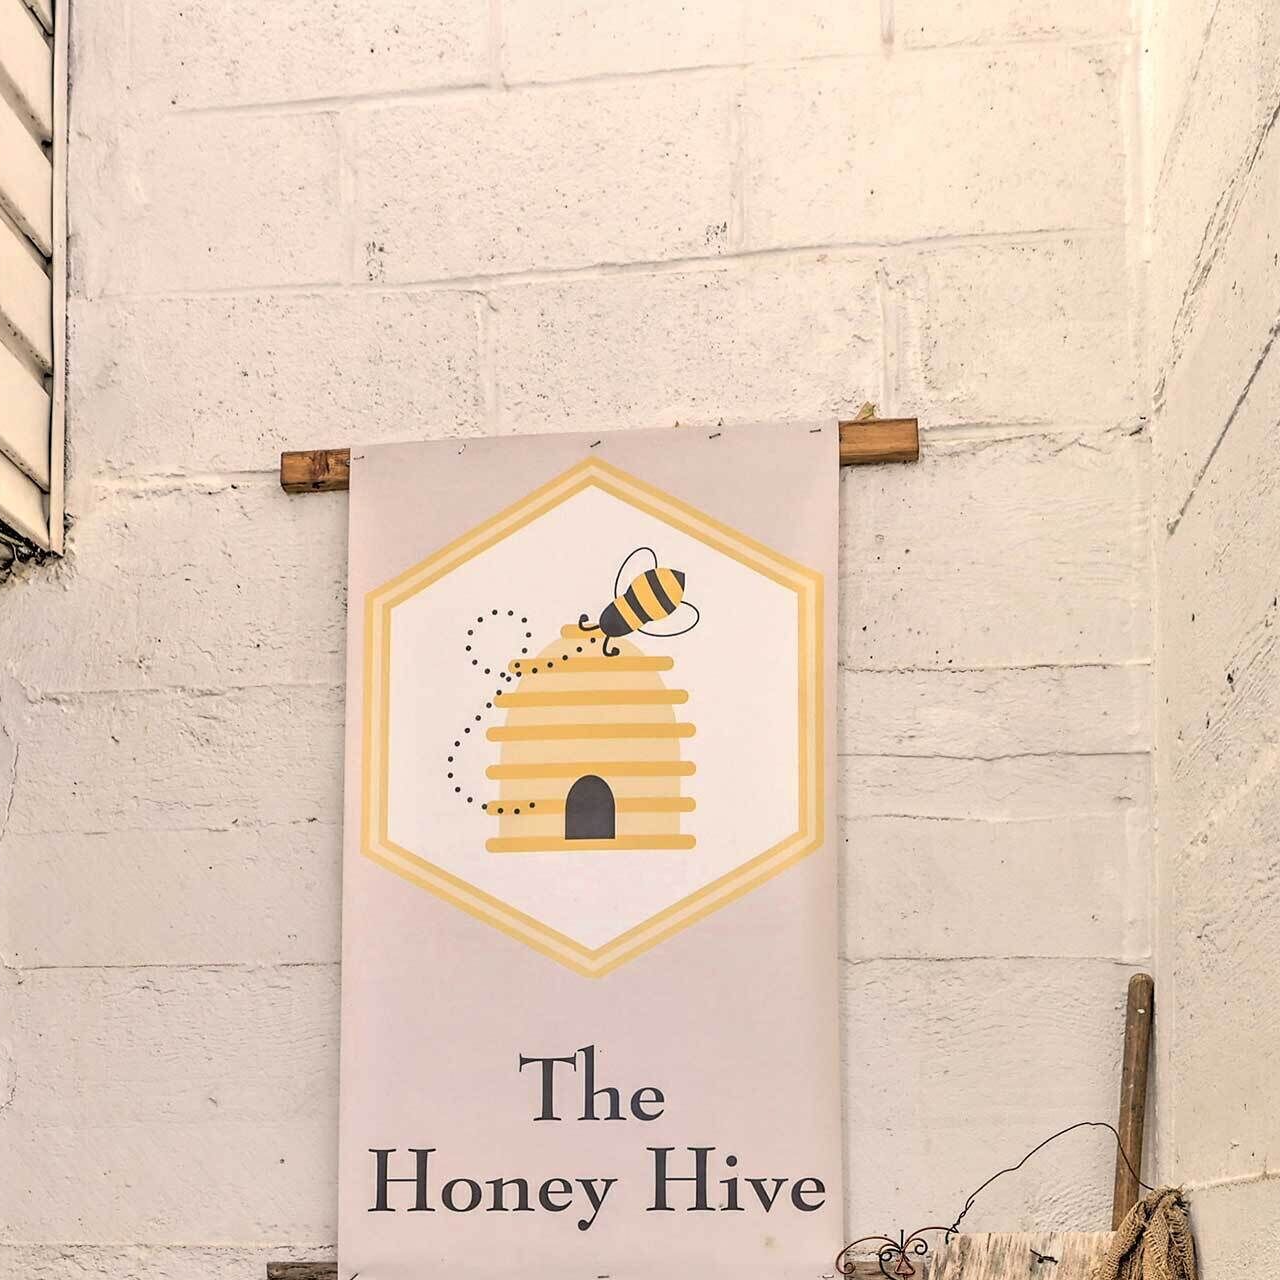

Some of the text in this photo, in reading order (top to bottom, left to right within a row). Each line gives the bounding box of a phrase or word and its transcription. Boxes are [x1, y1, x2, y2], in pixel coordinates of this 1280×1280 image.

[519, 1044, 666, 1122] The
[367, 1146, 826, 1231] Honey Hive
